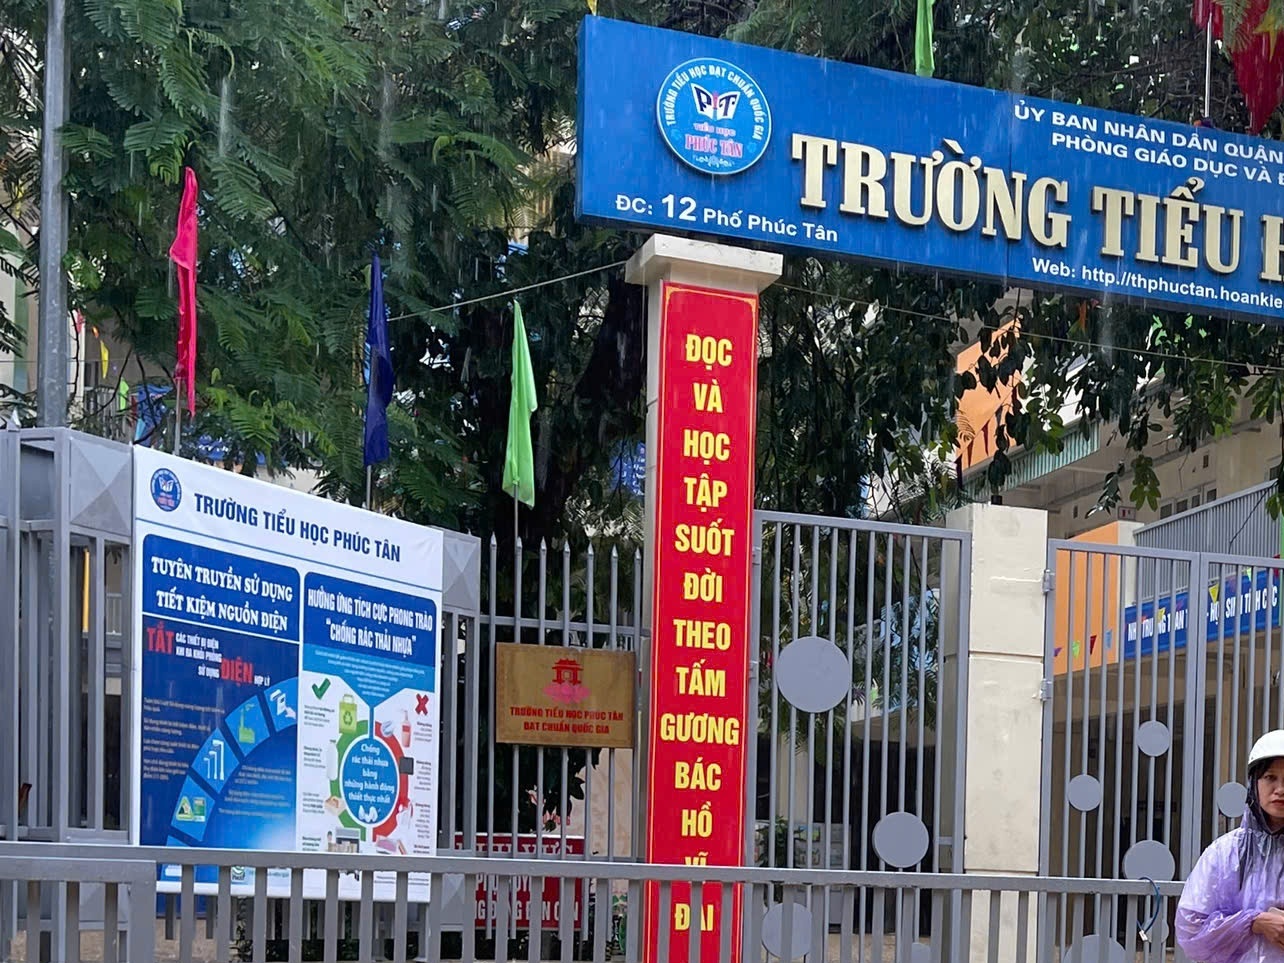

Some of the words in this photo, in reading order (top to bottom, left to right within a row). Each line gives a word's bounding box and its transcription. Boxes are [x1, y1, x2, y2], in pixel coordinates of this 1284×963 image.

[685, 133, 718, 153] PHÚC
[720, 139, 743, 158] TÂN
[1014, 100, 1045, 122] ỦY
[1052, 111, 1097, 132] BAN
[1104, 123, 1165, 144] NHÂN
[1172, 133, 1217, 153] DÂN
[1224, 143, 1283, 165] QUẬN
[1052, 132, 1128, 158] PHÒNG
[1134, 148, 1187, 168] GIÁO
[1193, 158, 1238, 178] DỤC
[1243, 165, 1272, 183] VÀ
[615, 193, 653, 215] ĐC:
[661, 193, 697, 222] 12
[703, 207, 744, 228] Phố
[748, 214, 798, 236] Phúc
[802, 222, 838, 243] Tân
[791, 132, 1073, 249] TRƯỜNG
[1092, 176, 1245, 275] TIỂU
[1032, 256, 1076, 279] Web:
[685, 333, 733, 371] ĐỌC
[692, 379, 724, 414] VÀ
[683, 429, 731, 465] HỌC
[683, 472, 728, 513] TẬP
[194, 493, 258, 527] TRƯỜNG
[263, 508, 296, 536] TIỂU
[300, 520, 329, 546] HỌC
[333, 530, 370, 554] PHÚC
[374, 539, 401, 562] TÂN
[674, 518, 735, 557] SUỐT
[151, 556, 192, 580] TUYÊN
[244, 573, 259, 595] SỬ
[262, 581, 293, 603] DỤNG
[683, 567, 723, 603] ĐỜI
[156, 586, 184, 611] TIẾT
[186, 595, 216, 619] KIỆM
[218, 601, 259, 626] NGUỒN
[261, 610, 288, 634] ĐIỆN
[308, 585, 335, 611] HƯỞNG
[336, 591, 353, 615] ỨNG
[354, 596, 371, 619] TÍCH
[372, 602, 388, 624] CỰC
[389, 606, 414, 628] PHONG
[415, 610, 433, 632] TRÀO
[358, 626, 373, 648] RÁC
[375, 628, 391, 651] THẢI
[672, 619, 732, 651] THEO
[220, 656, 254, 686] ĐIỆN
[675, 659, 727, 698] TẤM
[595, 724, 610, 734] GIA
[660, 711, 741, 746] GƯƠNG
[674, 757, 722, 791] BÁC
[681, 801, 714, 838] HỒ
